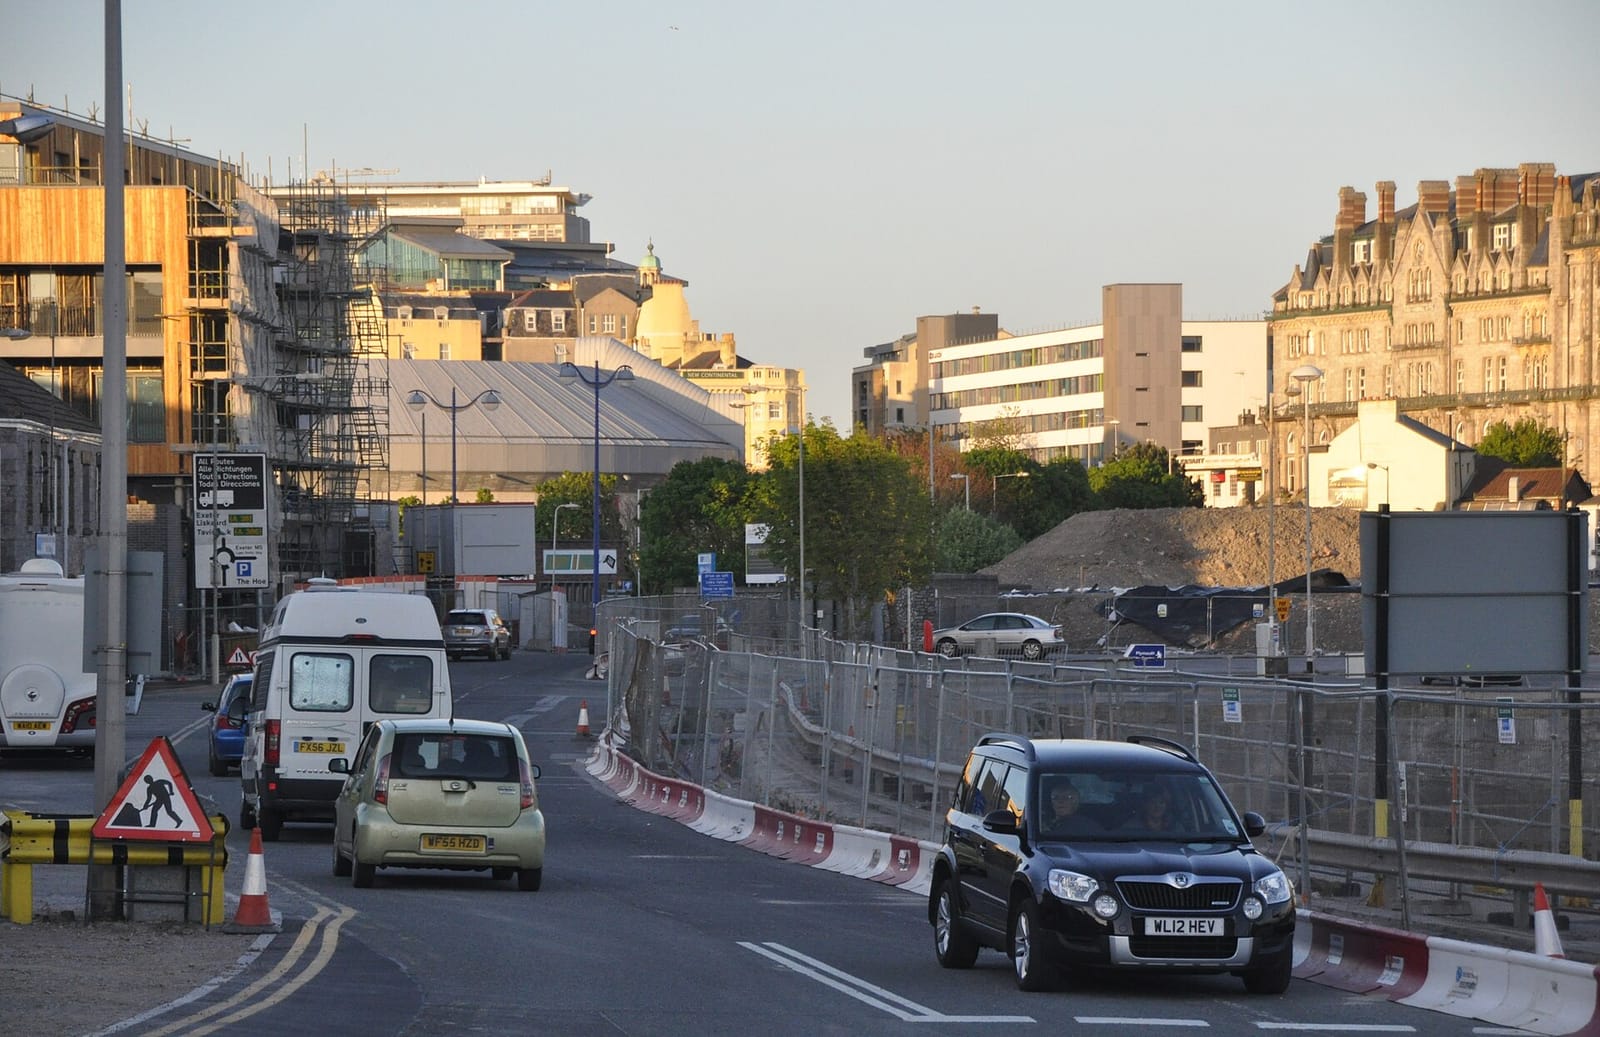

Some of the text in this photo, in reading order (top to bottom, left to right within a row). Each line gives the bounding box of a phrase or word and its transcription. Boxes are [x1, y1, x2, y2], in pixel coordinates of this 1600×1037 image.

[198, 472, 257, 480] Touts Directions
[300, 742, 343, 753] FX56 JZL
[428, 836, 480, 849] WF55 HZD
[1154, 919, 1215, 934] WL12 HEV
